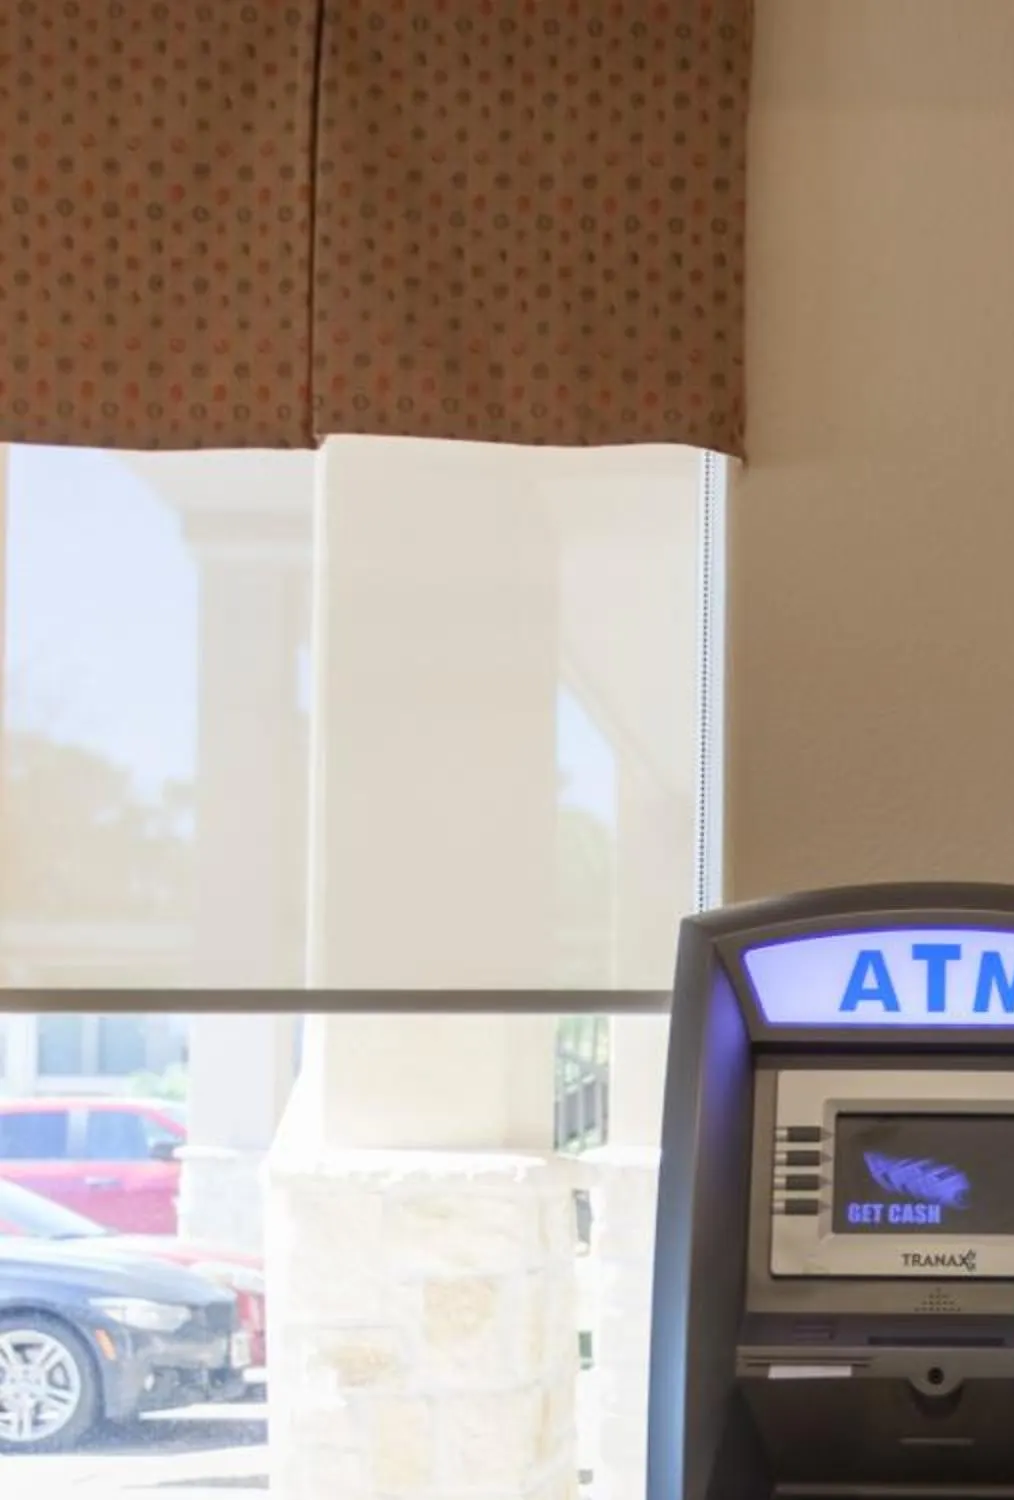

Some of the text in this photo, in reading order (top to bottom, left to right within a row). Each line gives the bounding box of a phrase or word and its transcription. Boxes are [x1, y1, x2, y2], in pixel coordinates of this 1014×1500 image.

[847, 1203, 940, 1225] GET CASH
[902, 1252, 976, 1270] TRANAX
